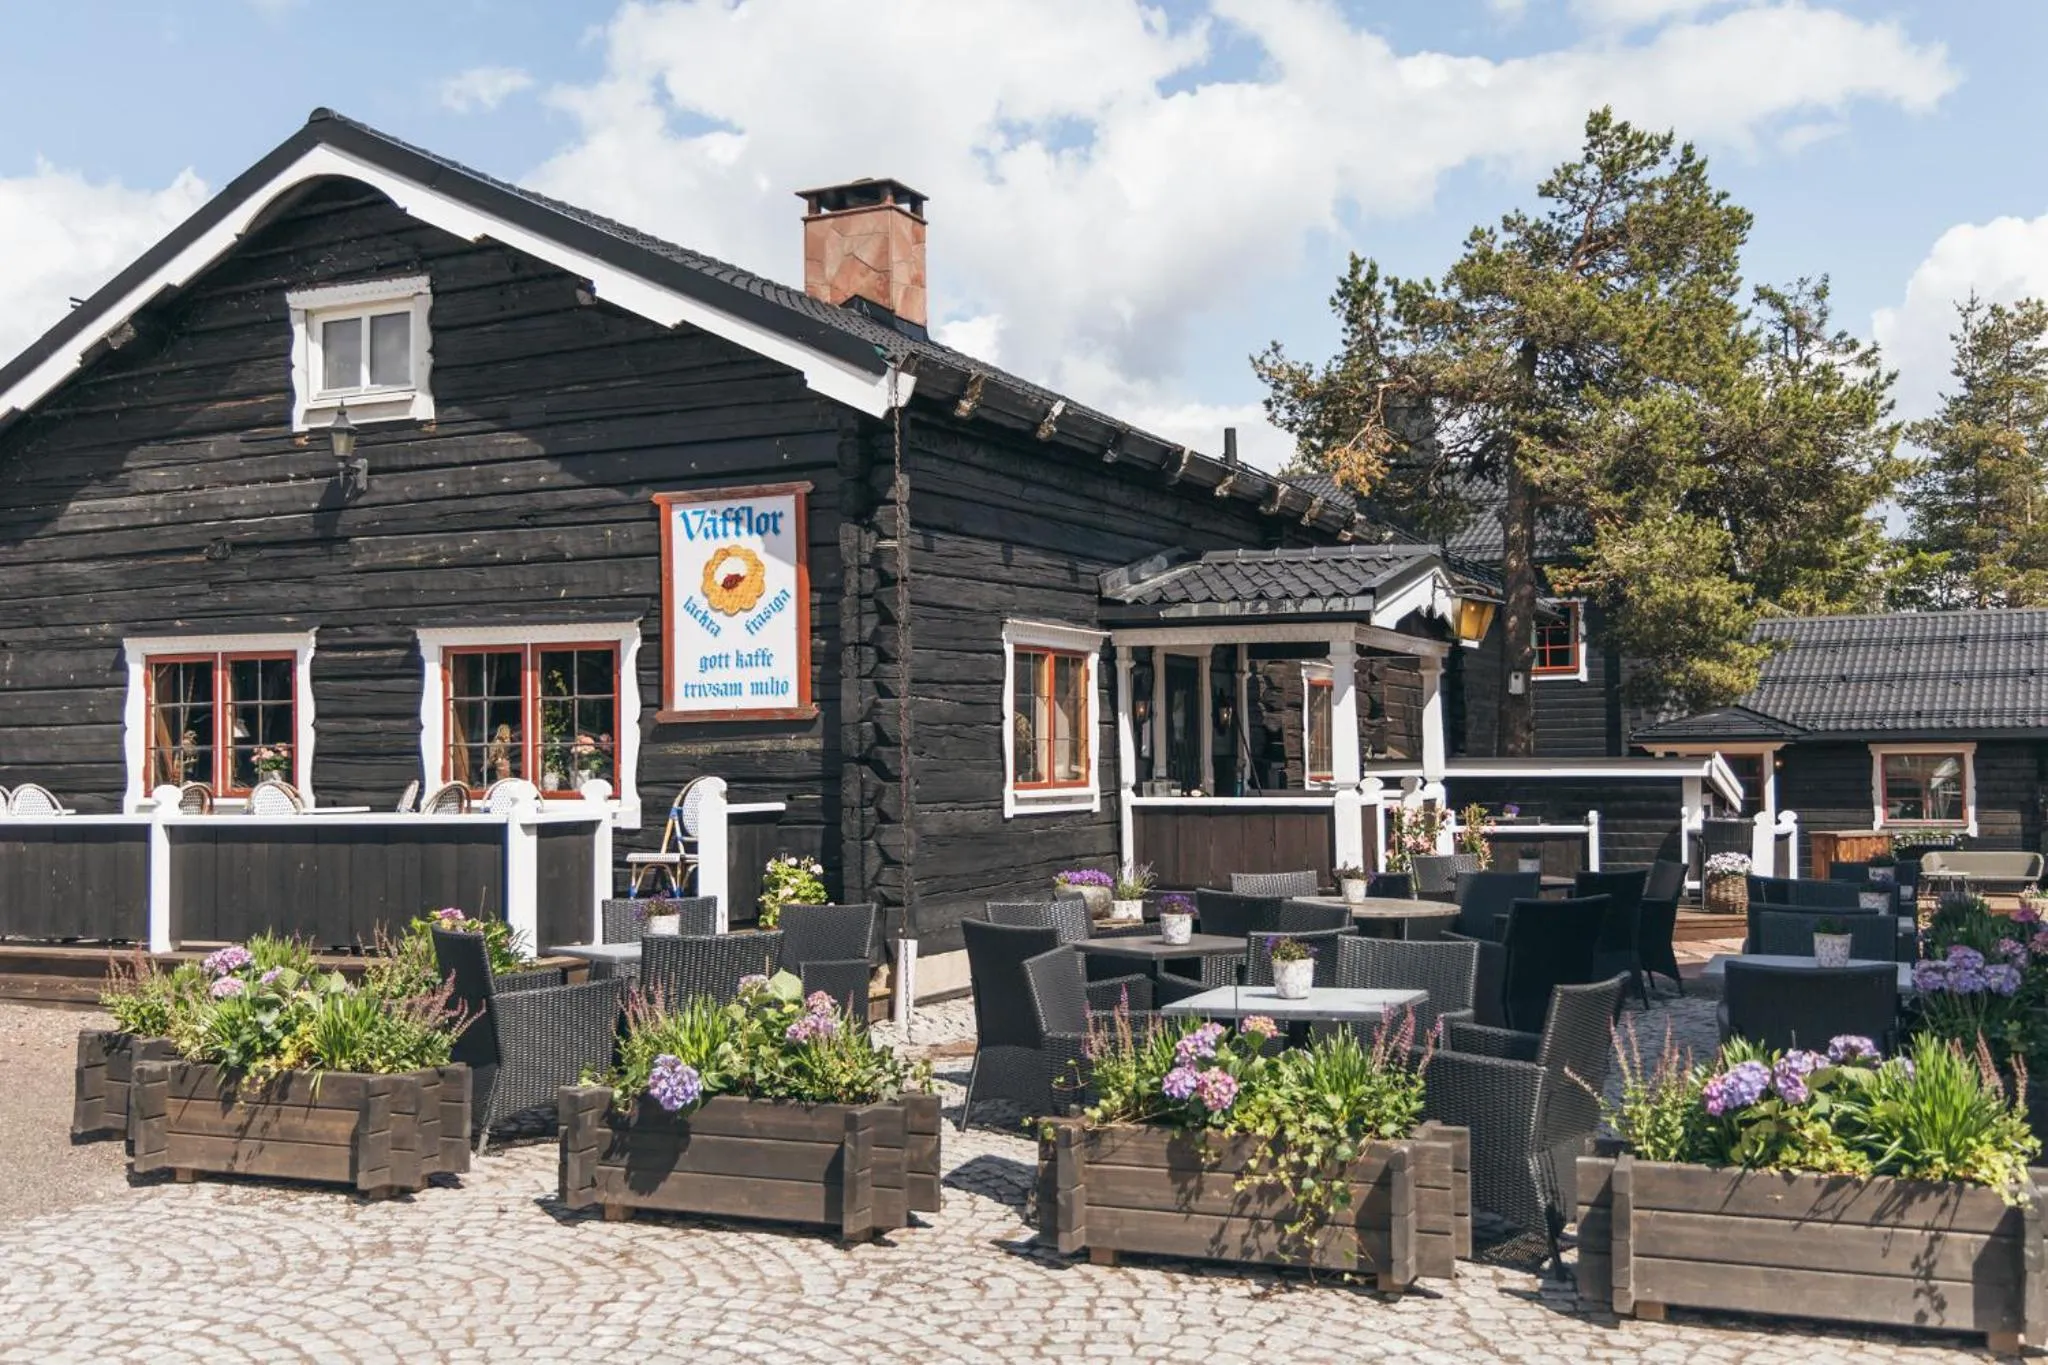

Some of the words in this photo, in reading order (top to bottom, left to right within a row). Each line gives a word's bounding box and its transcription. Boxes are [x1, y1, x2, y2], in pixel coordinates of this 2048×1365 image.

[699, 653, 730, 673] gott
[735, 647, 774, 669] kaffe
[683, 681, 743, 698] trivsam
